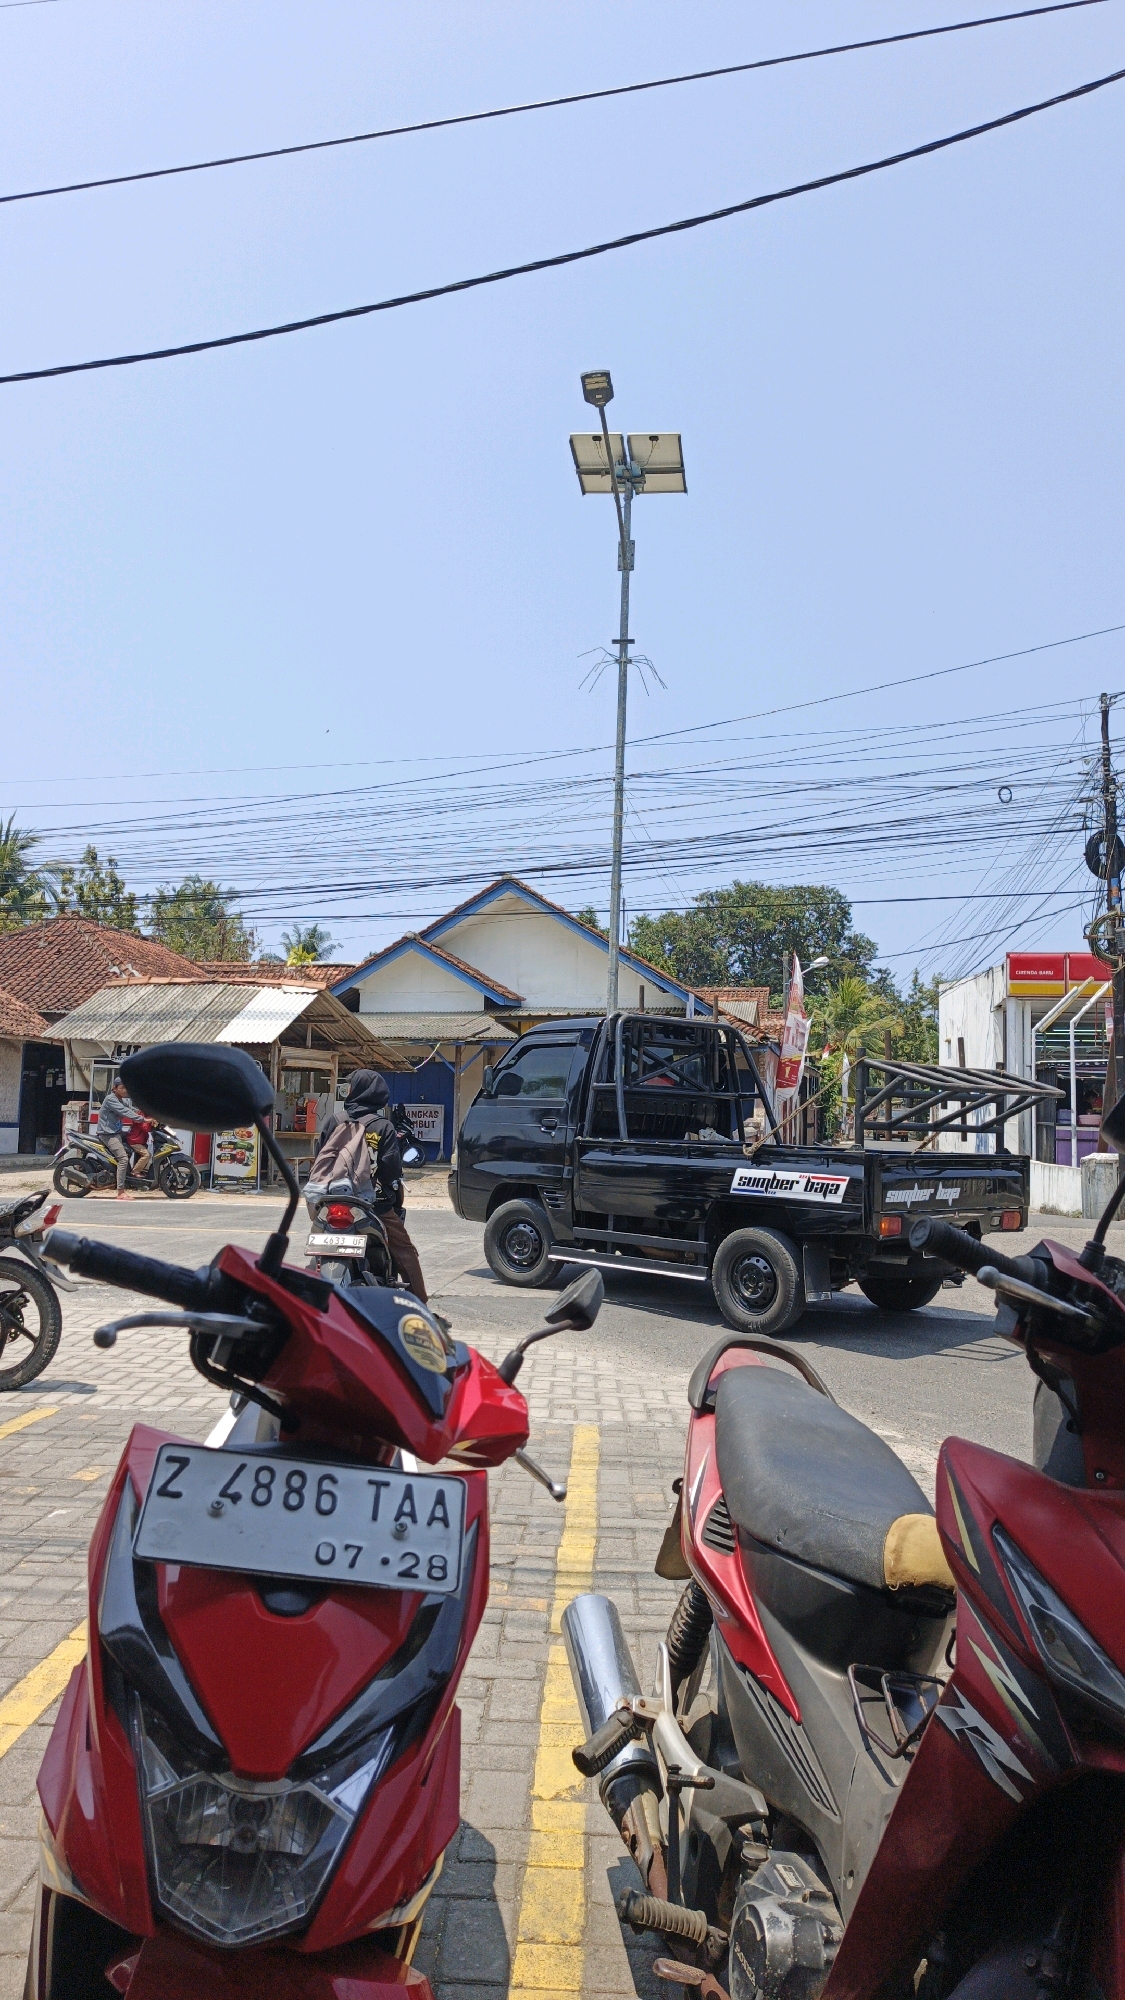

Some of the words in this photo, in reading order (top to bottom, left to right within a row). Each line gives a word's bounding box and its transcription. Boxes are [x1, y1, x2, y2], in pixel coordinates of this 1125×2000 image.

[407, 1110, 439, 1119] ANGKAS
[738, 1172, 799, 1195] sumber
[885, 1182, 934, 1208] sumber
[156, 1454, 191, 1498] Z
[219, 1463, 339, 1516] 4886
[367, 1478, 450, 1529] TAA
